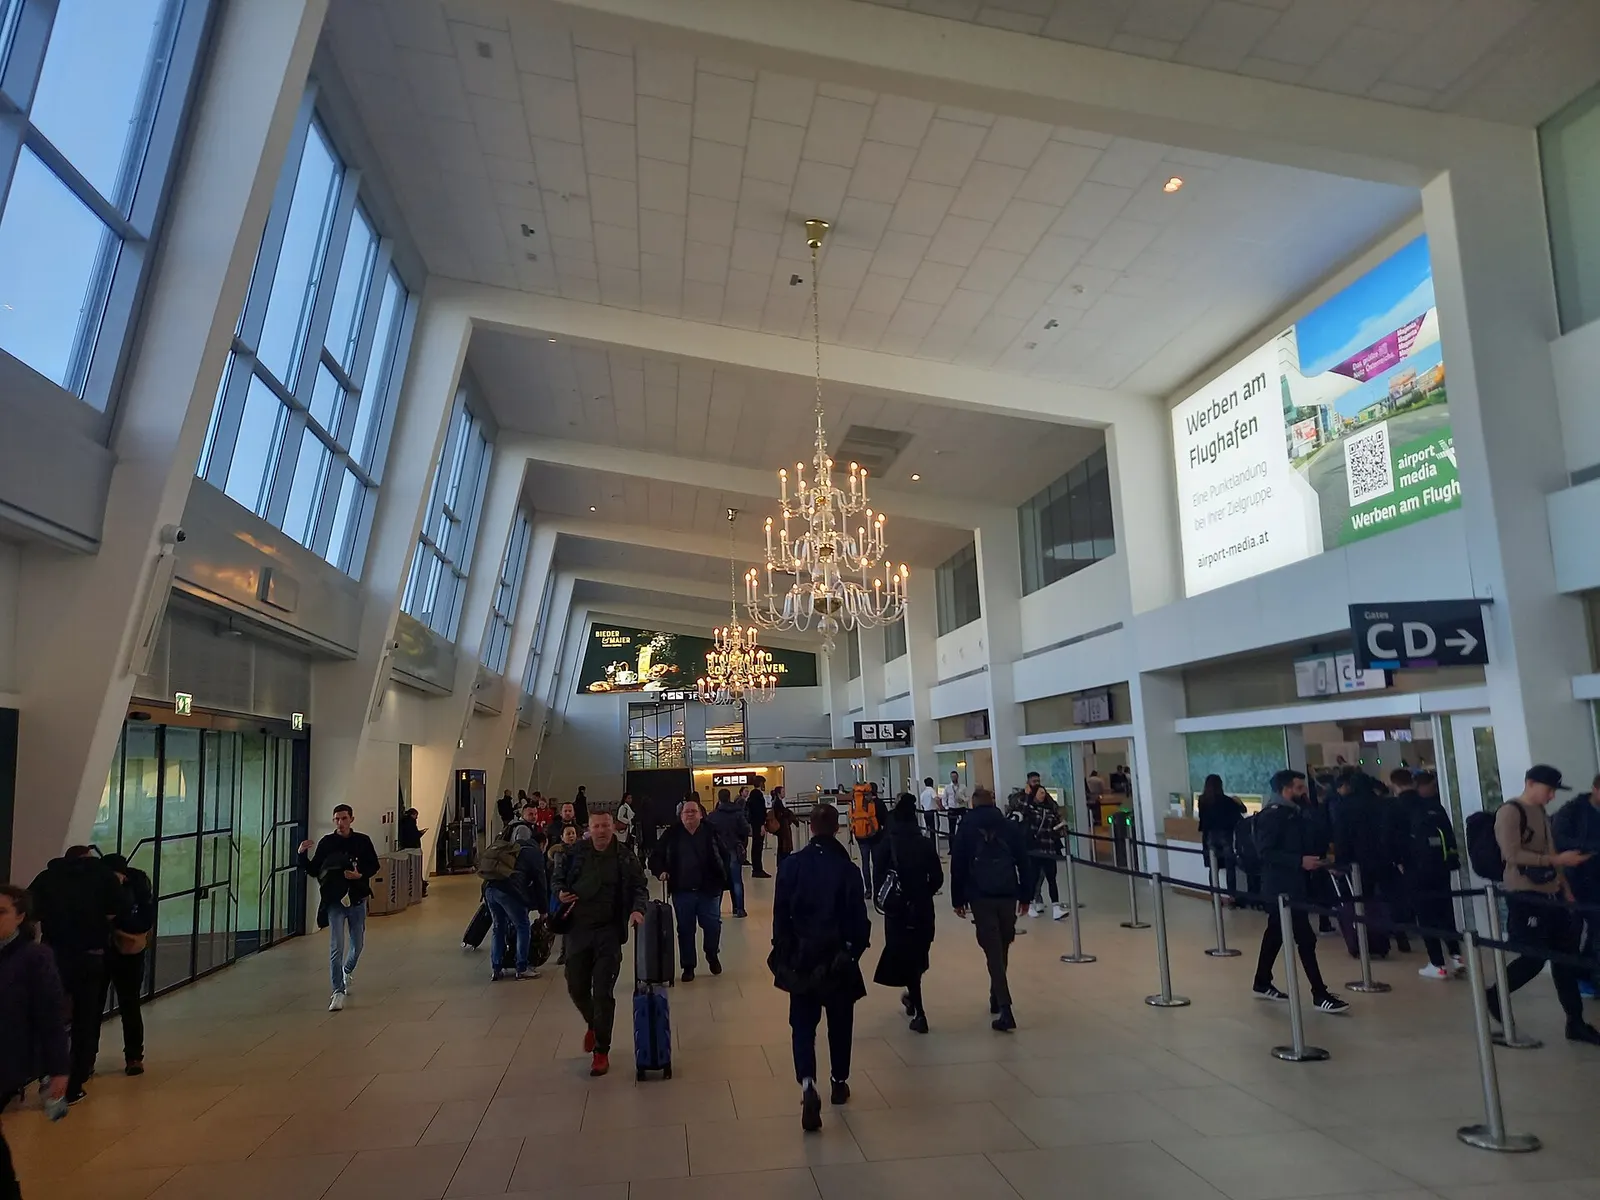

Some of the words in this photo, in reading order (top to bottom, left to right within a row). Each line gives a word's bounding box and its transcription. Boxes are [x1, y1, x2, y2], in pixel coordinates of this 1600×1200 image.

[1186, 390, 1238, 436] Werben
[1243, 372, 1267, 401] am
[1189, 416, 1258, 469] Flughafen
[1398, 444, 1436, 470] airport
[1192, 490, 1208, 507] Eine
[1209, 460, 1268, 499] Punktlandung
[1399, 462, 1438, 488] media
[1194, 516, 1206, 531] bei
[1351, 503, 1397, 530] Werben
[1399, 495, 1420, 514] am
[1197, 530, 1269, 568] airport-media.at
[1364, 611, 1389, 620] Gates
[595, 630, 620, 638] BIEDER
